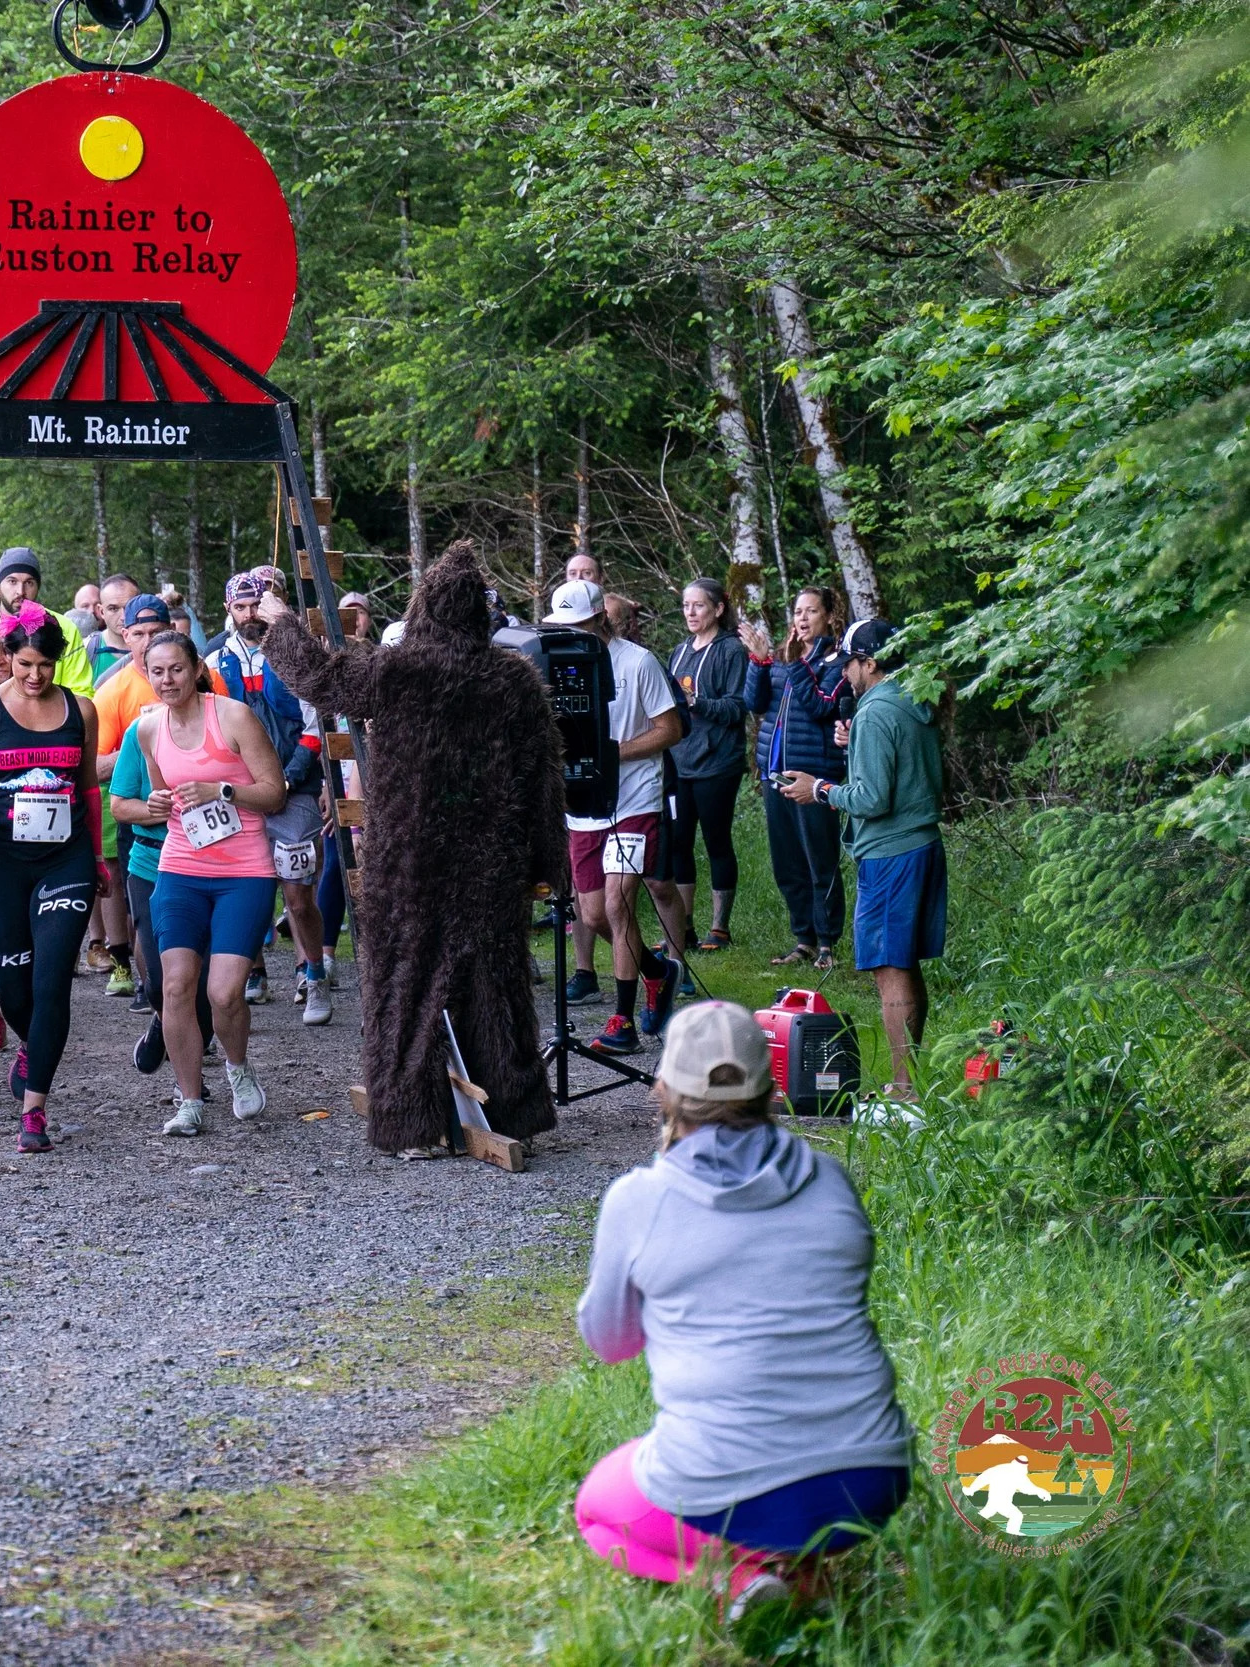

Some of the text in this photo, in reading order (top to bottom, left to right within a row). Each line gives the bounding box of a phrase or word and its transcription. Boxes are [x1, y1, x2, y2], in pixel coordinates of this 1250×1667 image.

[8, 199, 213, 233] Rainier to
[132, 242, 242, 283] Relay
[28, 415, 191, 446] Mt. Rainier
[0, 751, 26, 767] BEAST
[46, 807, 58, 832] 7
[202, 804, 231, 831] 56
[290, 852, 310, 872] 29
[616, 844, 637, 863] 67
[37, 898, 88, 915] PRO
